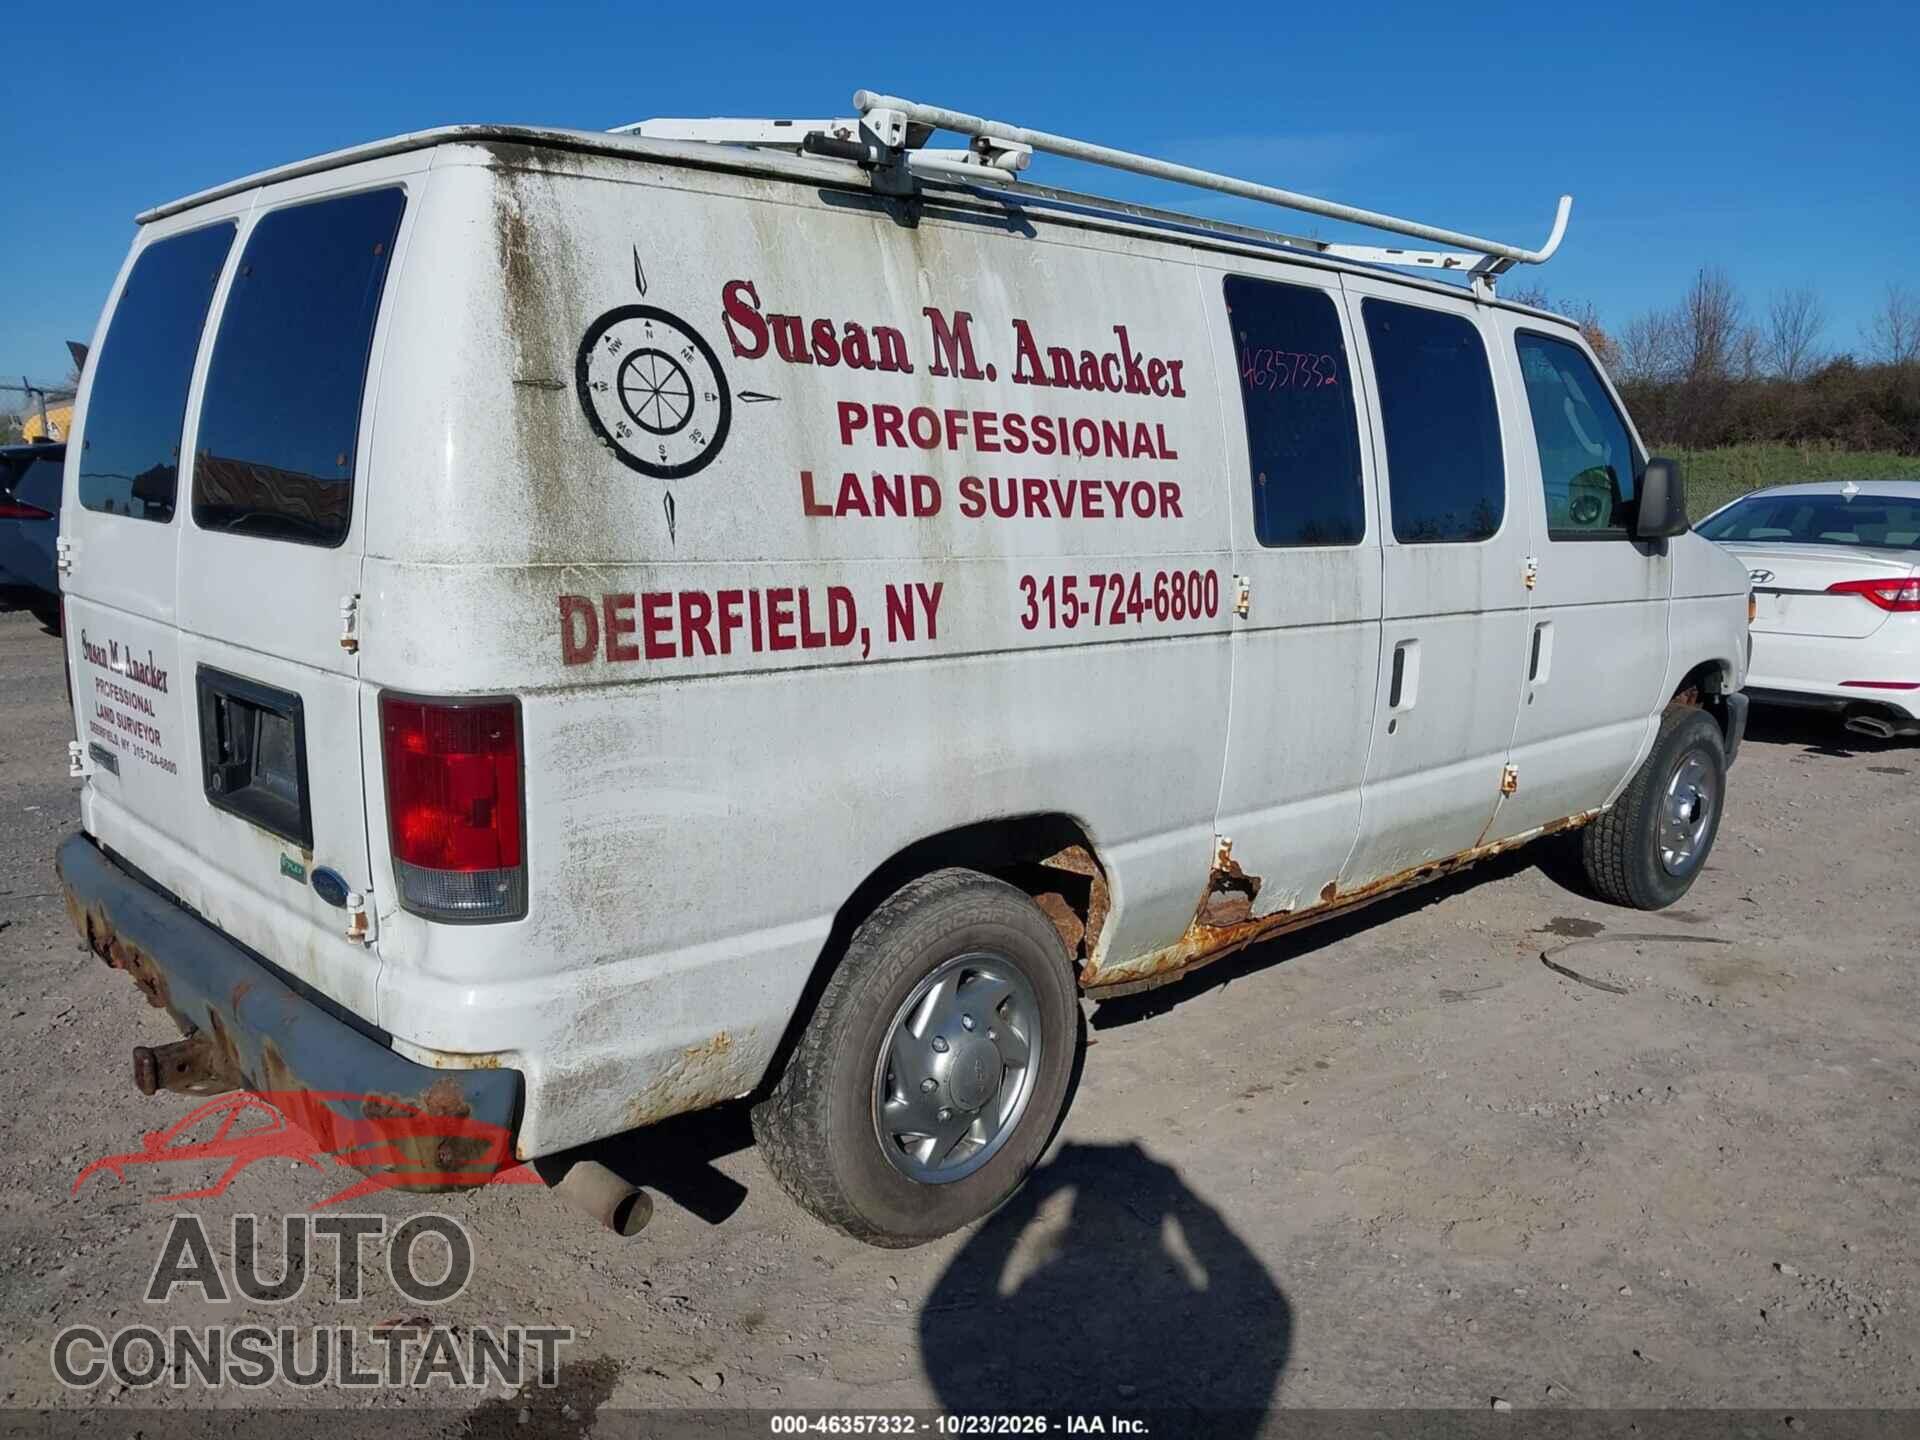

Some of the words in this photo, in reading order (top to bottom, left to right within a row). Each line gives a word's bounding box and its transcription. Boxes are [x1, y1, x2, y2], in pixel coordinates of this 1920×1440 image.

[607, 338, 624, 356] NW
[645, 329, 654, 339] N
[721, 280, 914, 374] Susan
[923, 306, 997, 382] M.
[1012, 319, 1187, 398] Anacker
[680, 348, 695, 364] NE
[1241, 345, 1338, 392] 46357332
[598, 380, 609, 392] W
[704, 391, 711, 402] E
[615, 420, 633, 438] SW
[688, 428, 702, 444] SE
[836, 401, 1178, 460] PROFESSIONAL
[658, 444, 666, 454] S
[800, 471, 942, 518] LAND
[958, 477, 1184, 519] SURVEYOR
[559, 585, 871, 665] DEERFIELD,
[885, 583, 944, 641] NY
[1019, 568, 1219, 630] 315-724-6800
[81, 628, 108, 670] Susan
[125, 645, 168, 694] Anacker
[95, 677, 155, 718] PROFESSIONAL
[95, 701, 115, 725] LAND
[116, 711, 162, 748] SURVEYOR
